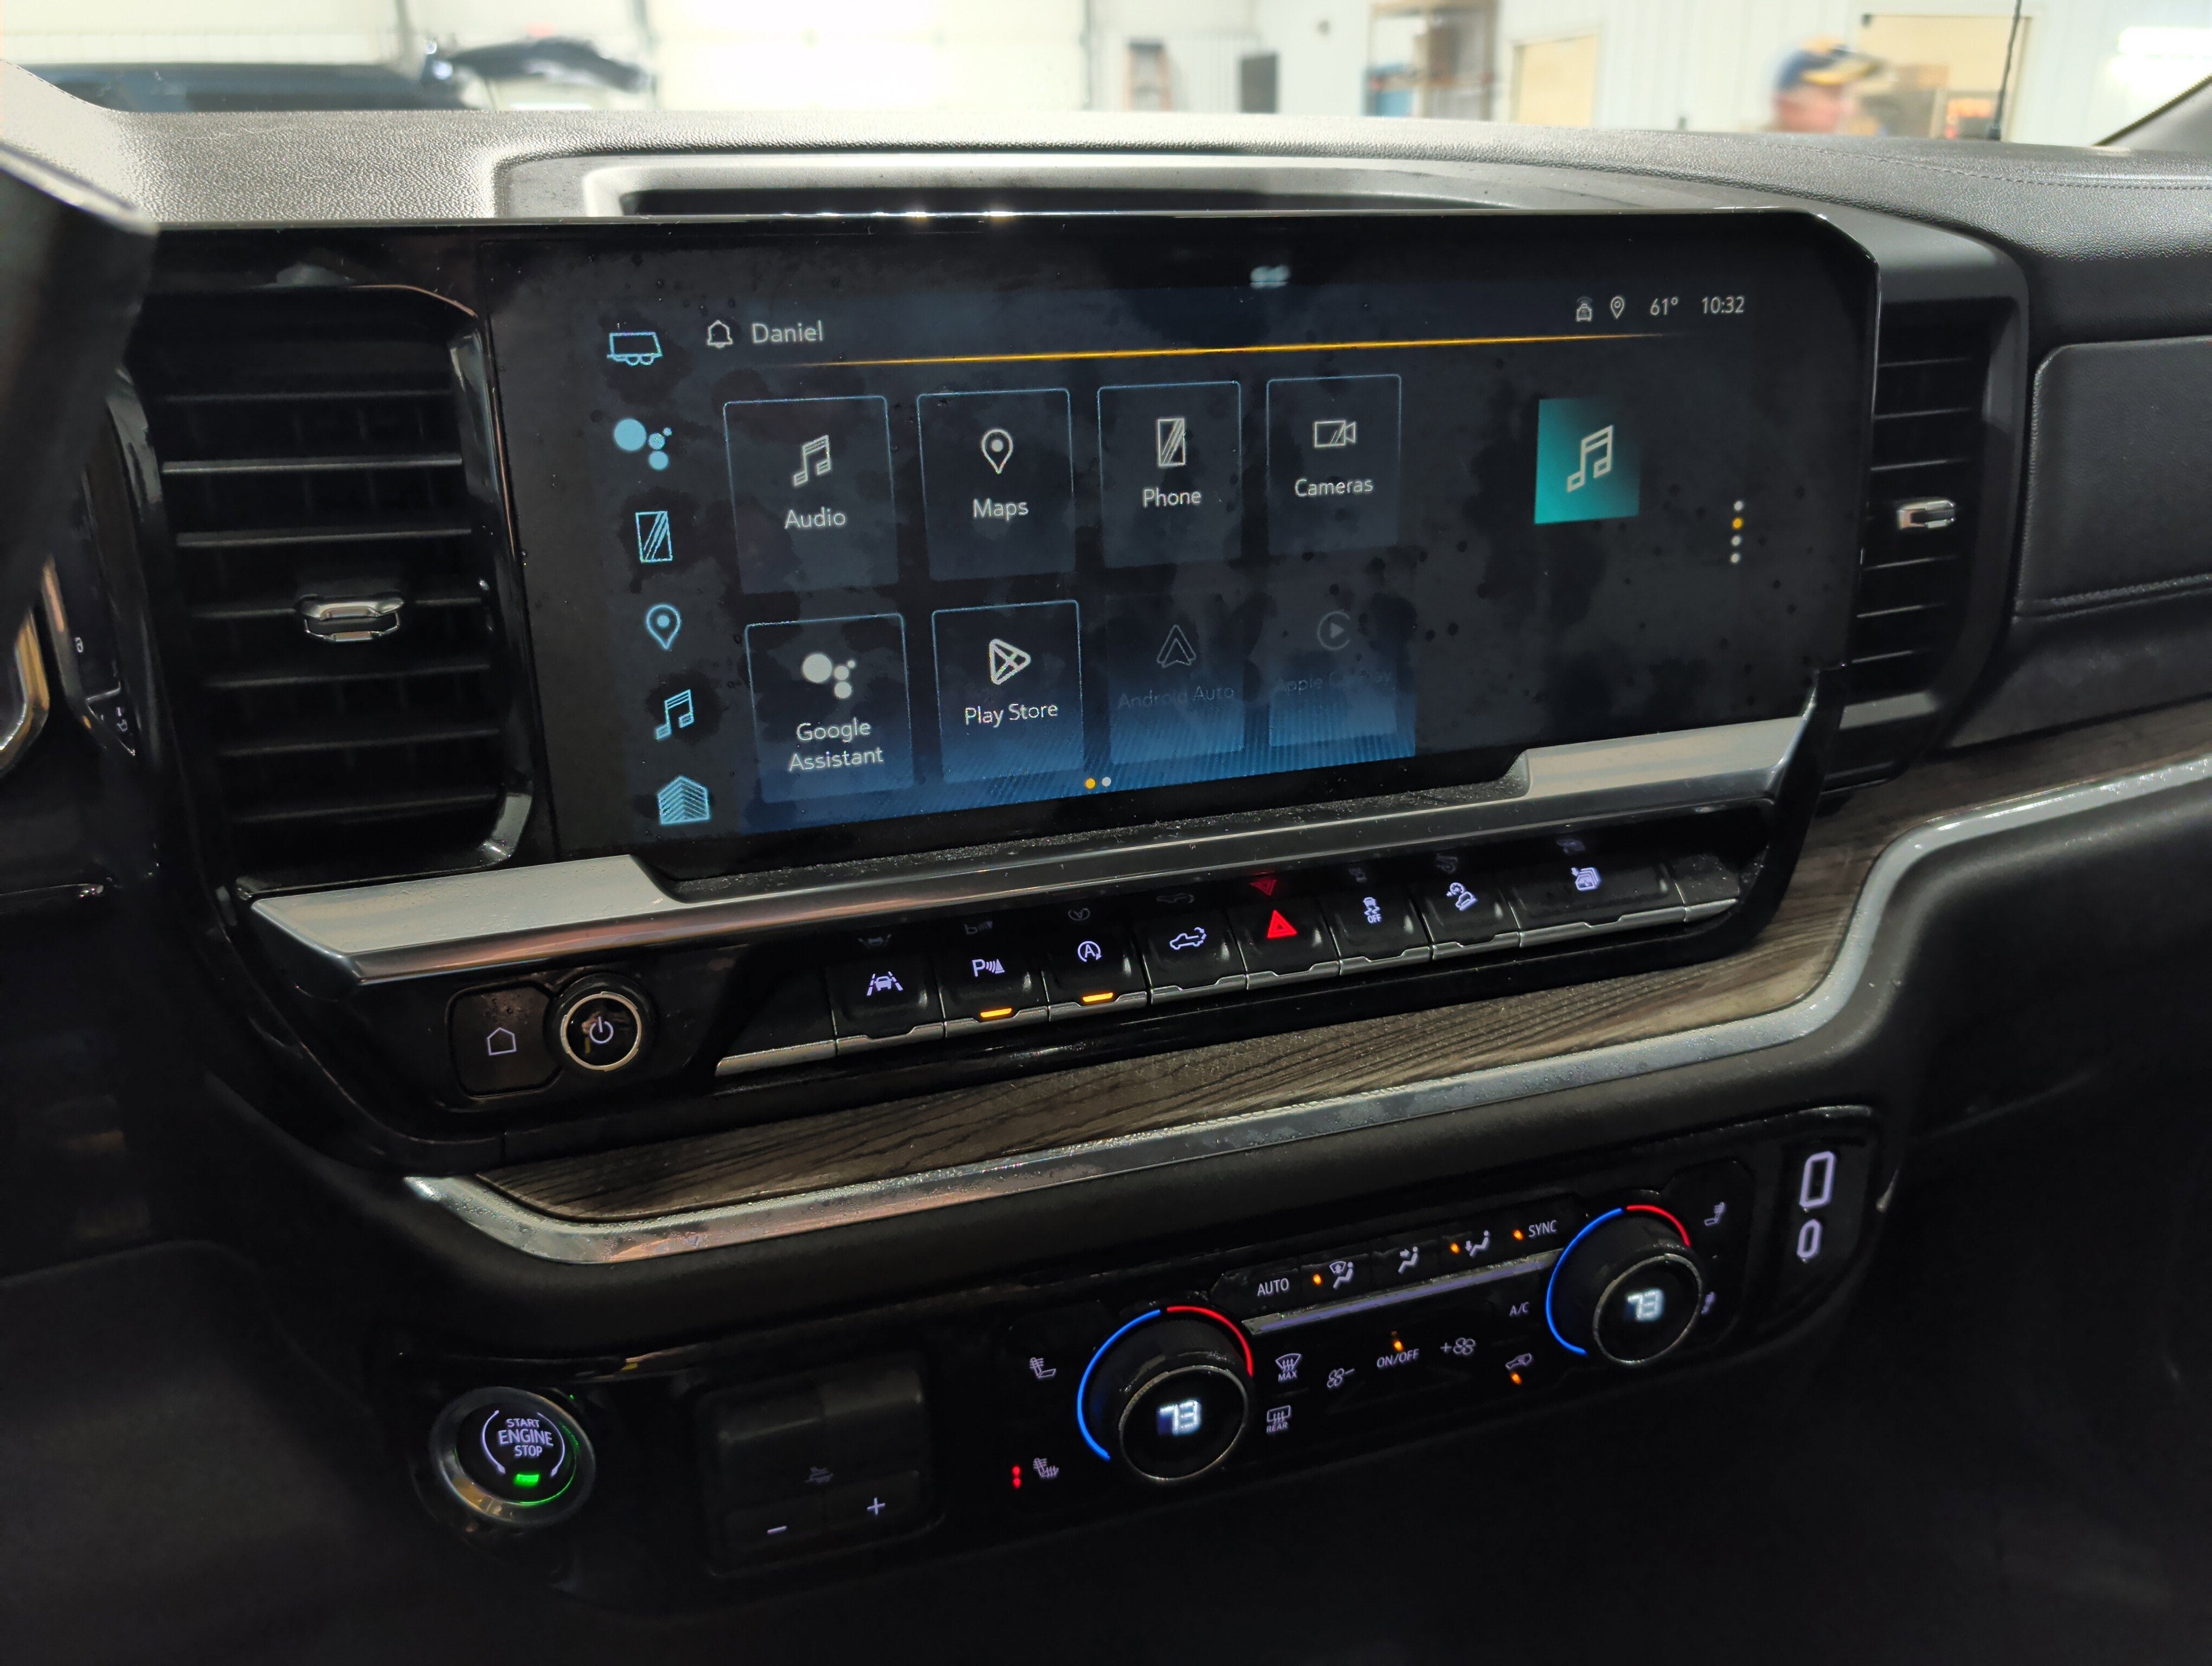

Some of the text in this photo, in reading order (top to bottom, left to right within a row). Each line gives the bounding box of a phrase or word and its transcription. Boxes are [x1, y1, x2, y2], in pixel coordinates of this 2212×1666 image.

[1701, 296, 1745, 314] 10:32
[752, 320, 824, 344] Daniel
[1142, 487, 1202, 508] Phone
[1295, 477, 1373, 498] Cameras
[785, 507, 846, 529] Audio
[973, 498, 1029, 521] Maps
[1193, 685, 1234, 702] Auto
[1277, 672, 1323, 696] pple
[965, 702, 1058, 728] Play Store
[796, 716, 871, 743] Google
[788, 746, 884, 772] Assistant
[1367, 913, 1382, 924] OFF
[972, 958, 986, 977] P
[1528, 1220, 1557, 1238] SYNC
[1257, 1278, 1290, 1297] AUTO
[1509, 1302, 1530, 1317] A/C
[1627, 1288, 1664, 1321] 73
[1377, 1348, 1420, 1369] ON/OFF
[1278, 1370, 1298, 1382] MAX
[506, 1418, 540, 1428] START
[1159, 1399, 1201, 1435] 73
[498, 1428, 554, 1447] ENGINE
[1266, 1421, 1288, 1434] REAR
[515, 1445, 543, 1457] STOP
